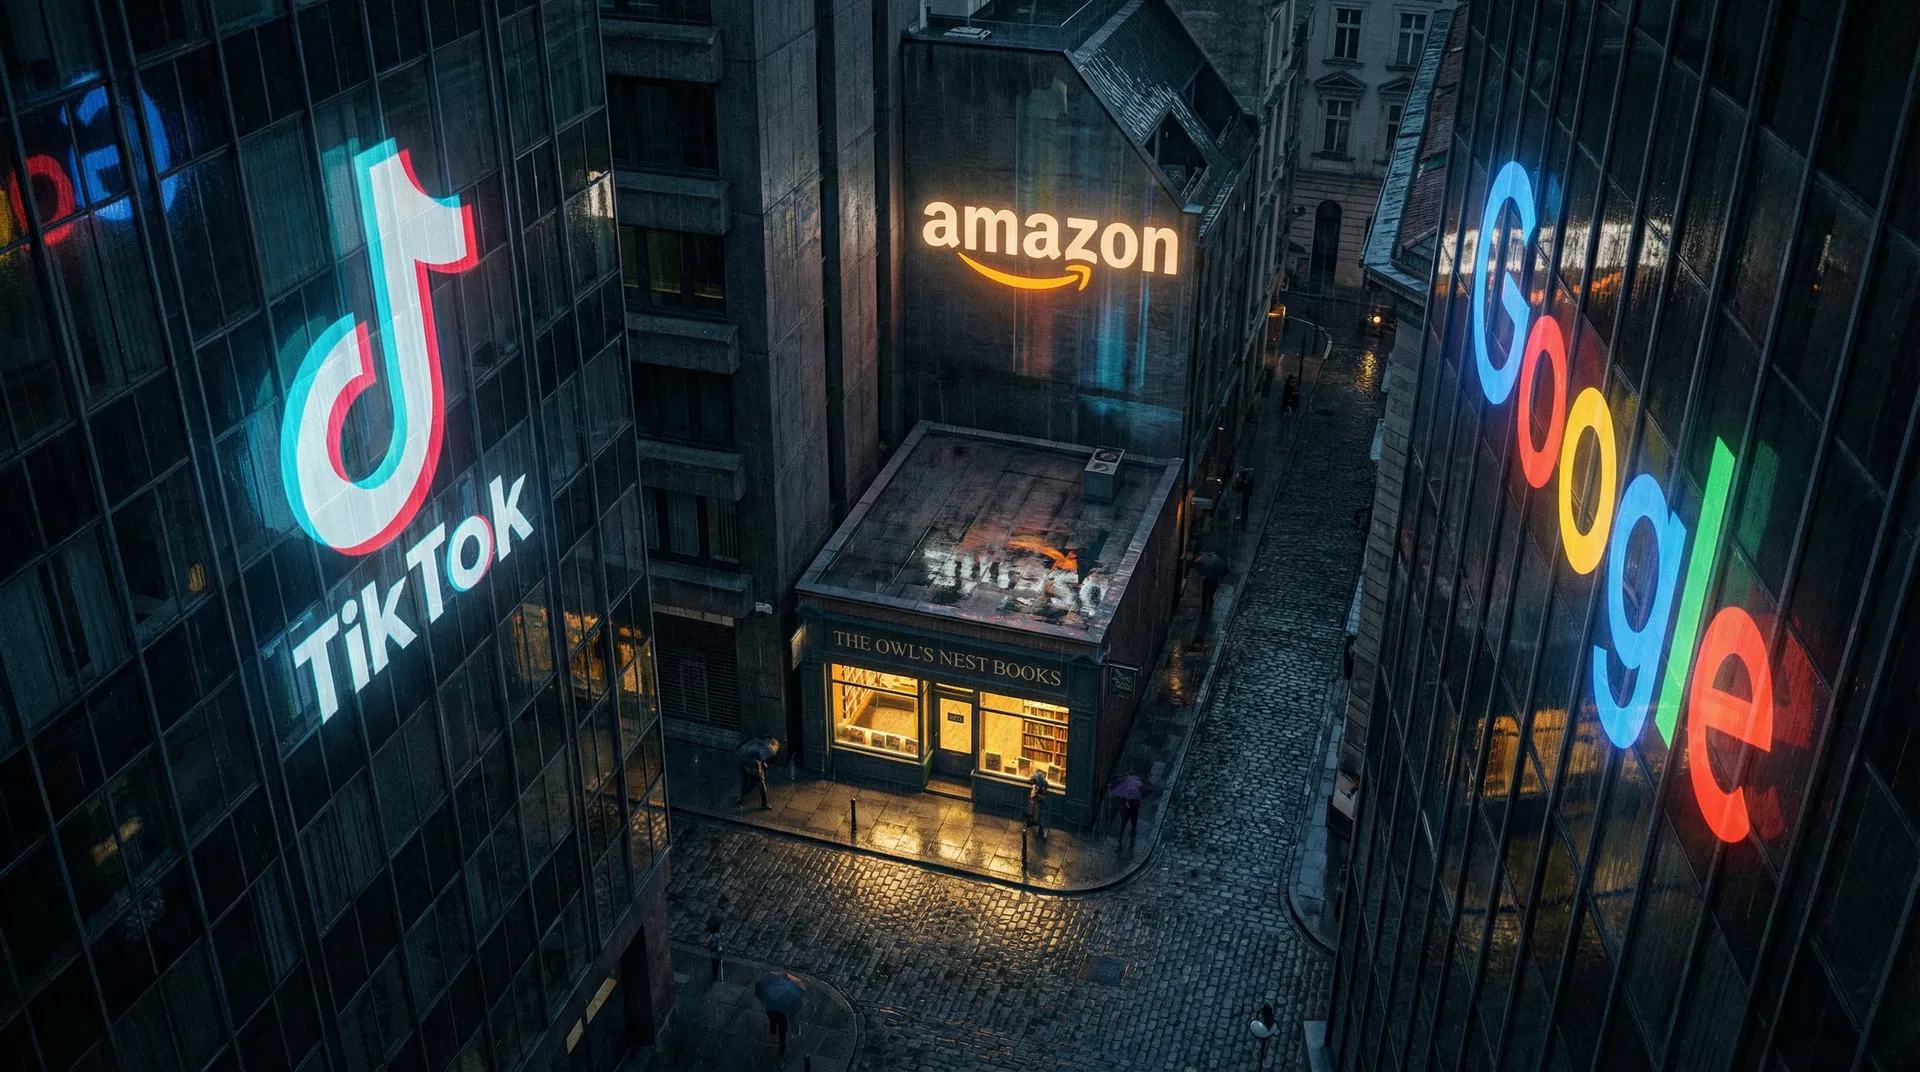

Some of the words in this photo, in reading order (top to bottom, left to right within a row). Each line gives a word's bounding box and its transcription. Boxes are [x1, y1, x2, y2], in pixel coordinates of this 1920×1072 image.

[922, 201, 1179, 276] amazon
[1473, 161, 1774, 843] Google
[292, 473, 534, 725] TikTok
[833, 630, 871, 651] THE
[875, 638, 934, 663] OWL'S
[938, 649, 989, 672] NEST
[993, 659, 1062, 687] BOOKS
